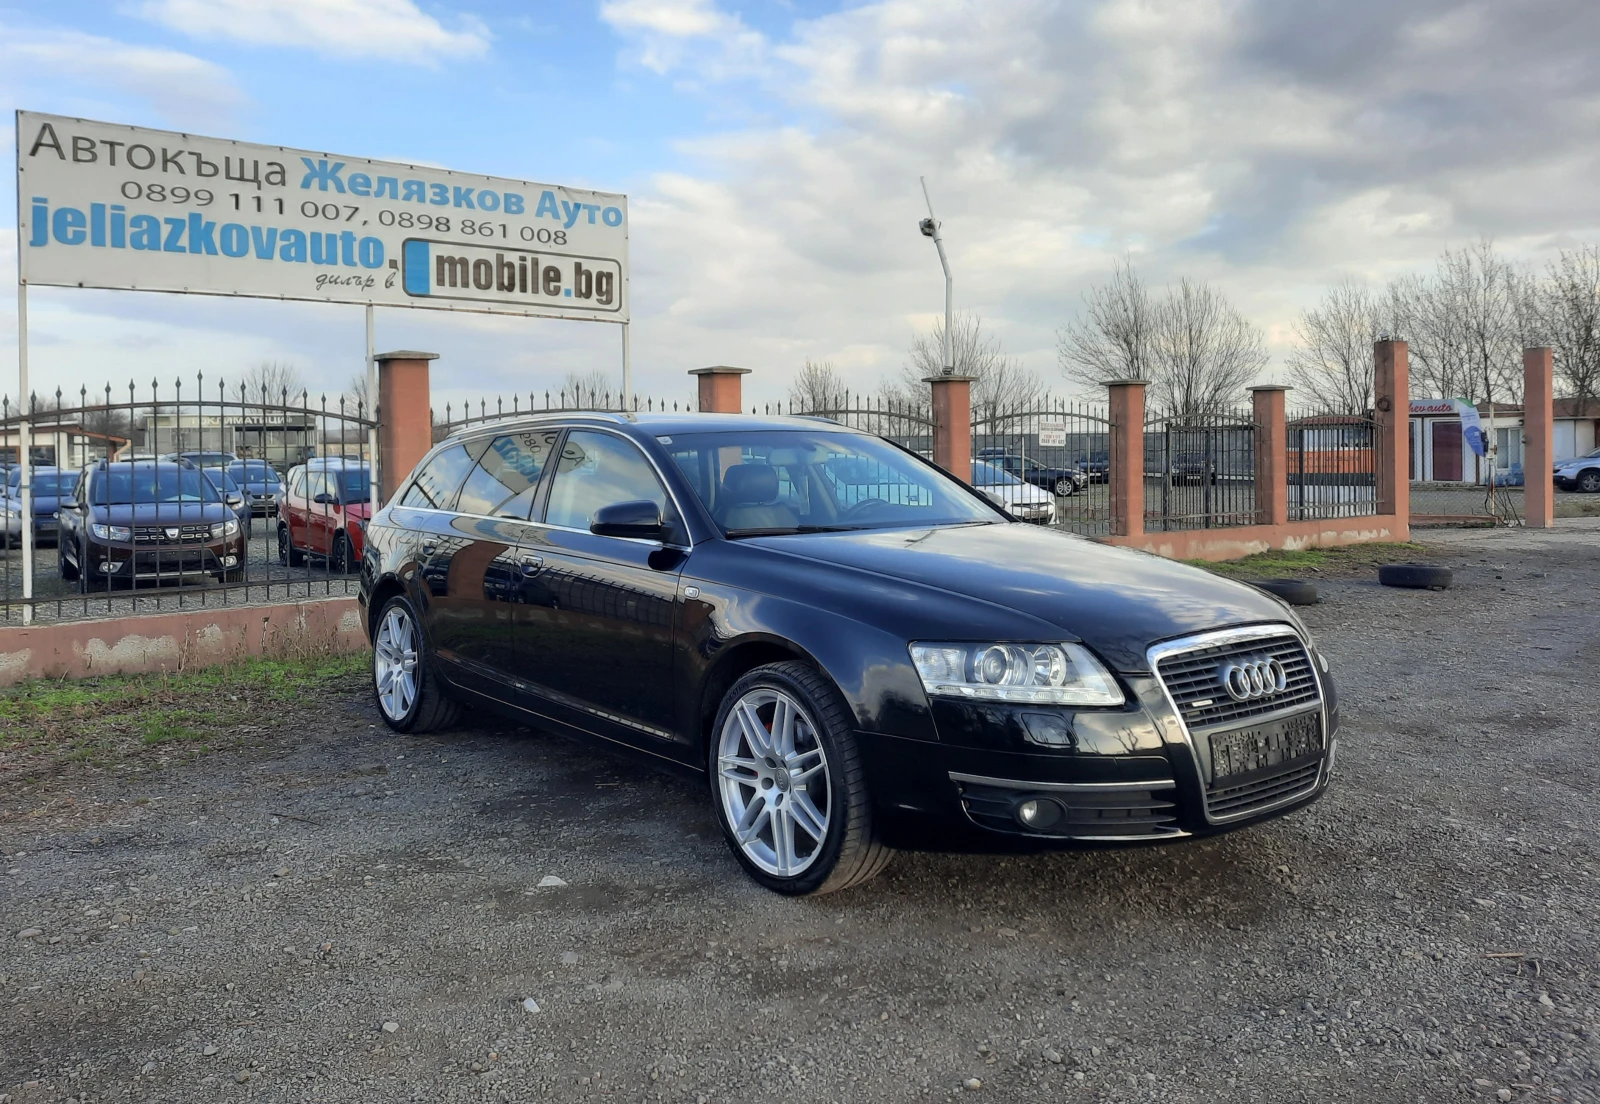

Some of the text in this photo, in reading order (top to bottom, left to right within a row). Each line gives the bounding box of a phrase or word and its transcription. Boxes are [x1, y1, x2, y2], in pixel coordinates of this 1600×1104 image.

[29, 122, 623, 229] Автокъща Желязков Ауто
[121, 181, 568, 245] 0899 111 007, 0898 861 008
[316, 272, 376, 291] дилър
[435, 252, 614, 306] mobile.bg
[1427, 403, 1453, 412] auto
